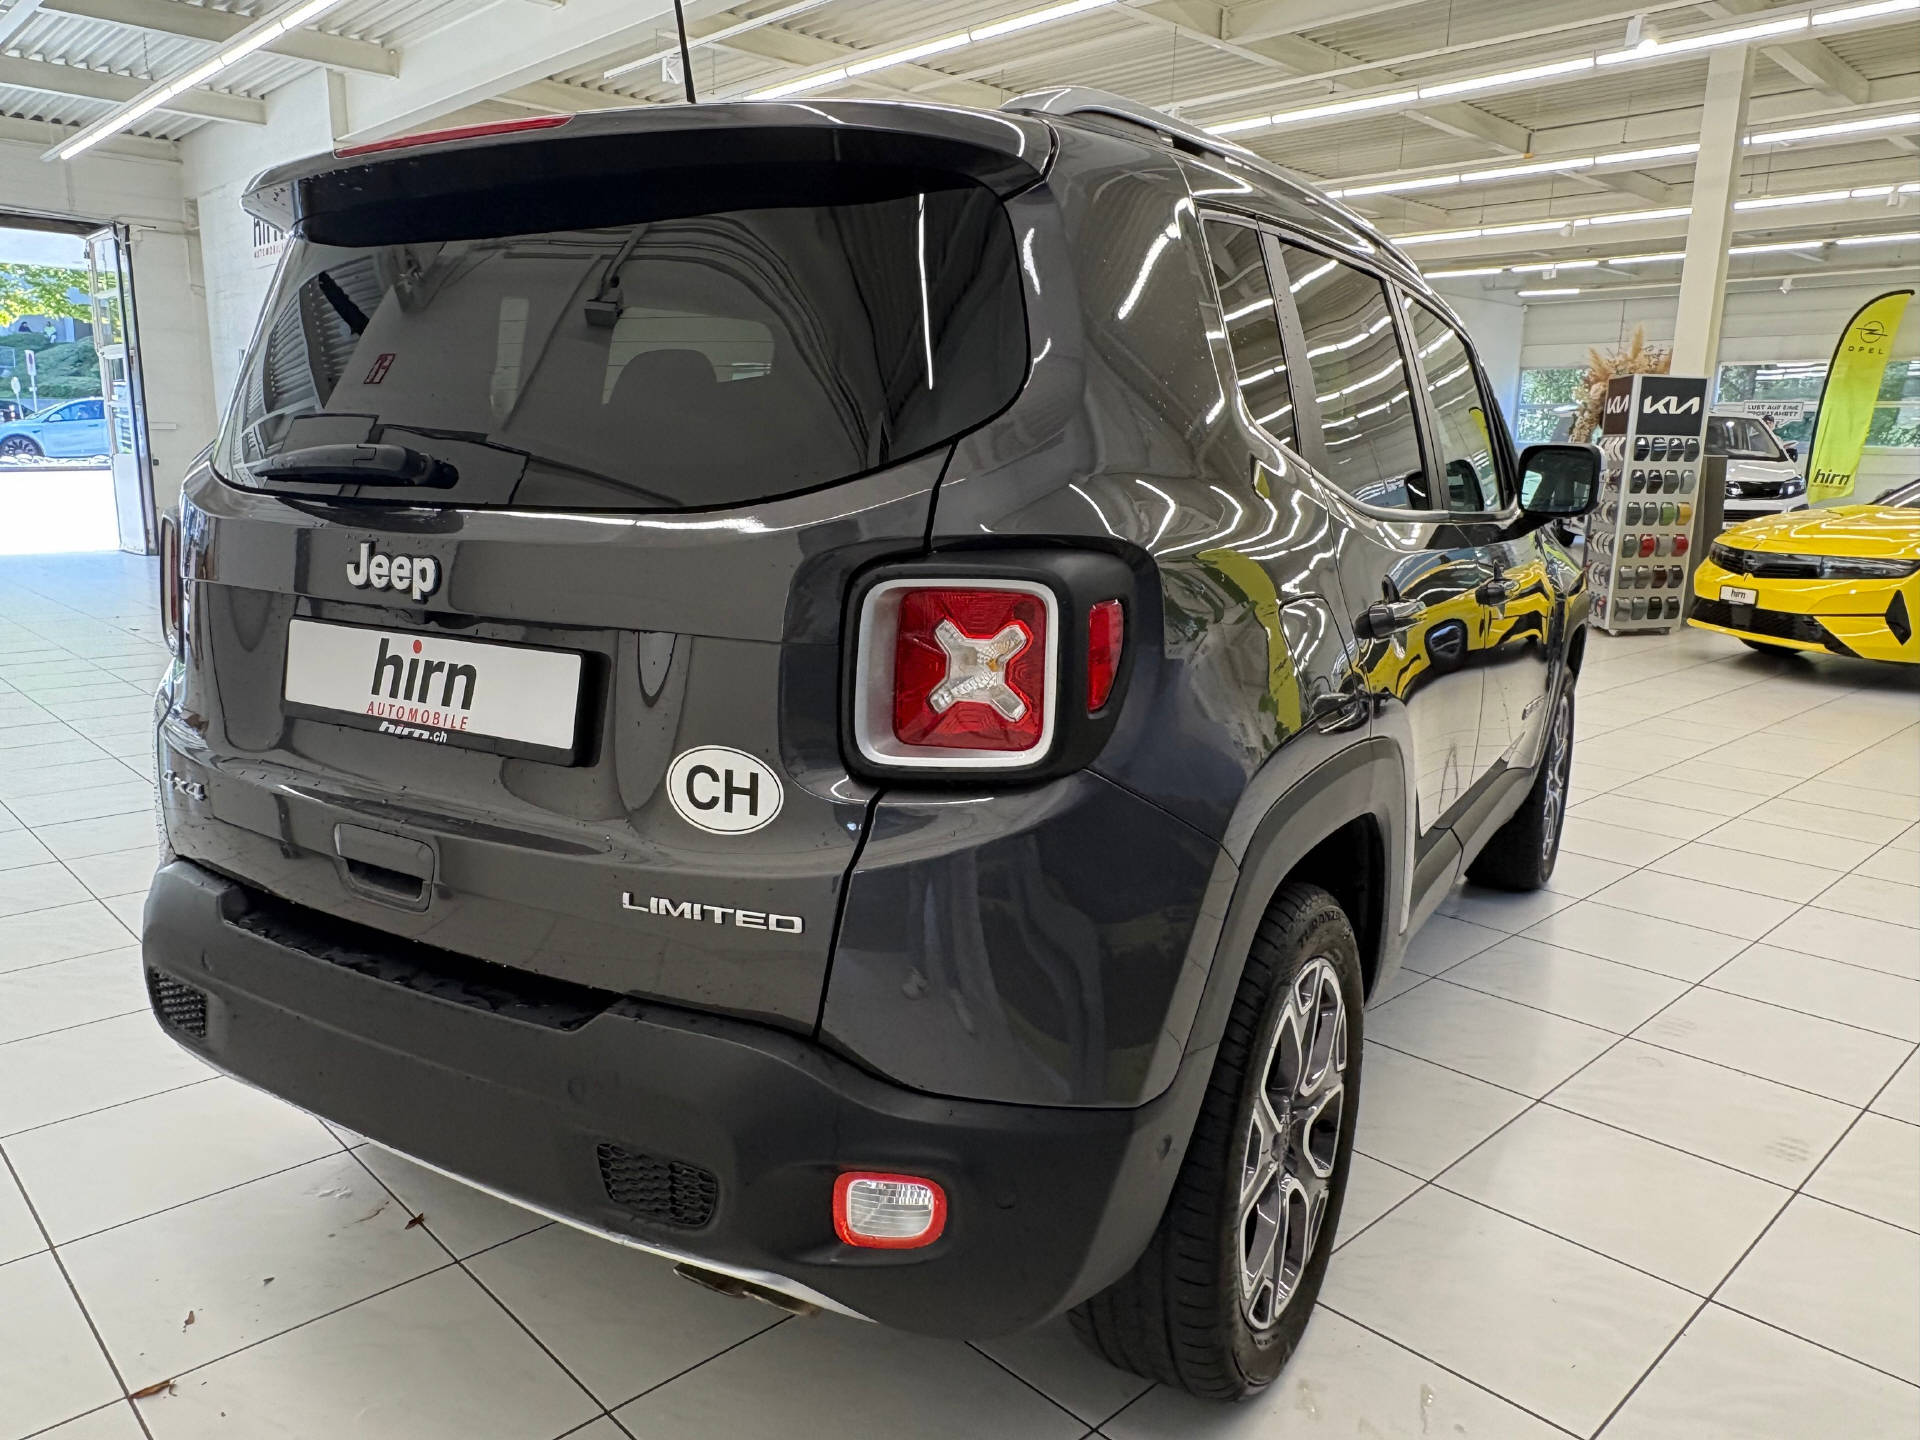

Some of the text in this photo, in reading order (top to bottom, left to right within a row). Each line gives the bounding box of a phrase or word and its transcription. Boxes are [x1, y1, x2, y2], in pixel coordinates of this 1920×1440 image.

[1847, 345, 1884, 355] OPEL
[1643, 395, 1701, 415] KIA
[1813, 468, 1851, 486] hirn
[346, 542, 439, 600] Jeep
[371, 638, 477, 710] hirn
[366, 701, 469, 730] AUTOMOBILE
[379, 720, 447, 743] hirn.ch
[686, 764, 759, 817] CH
[622, 891, 803, 934] LIMITED
